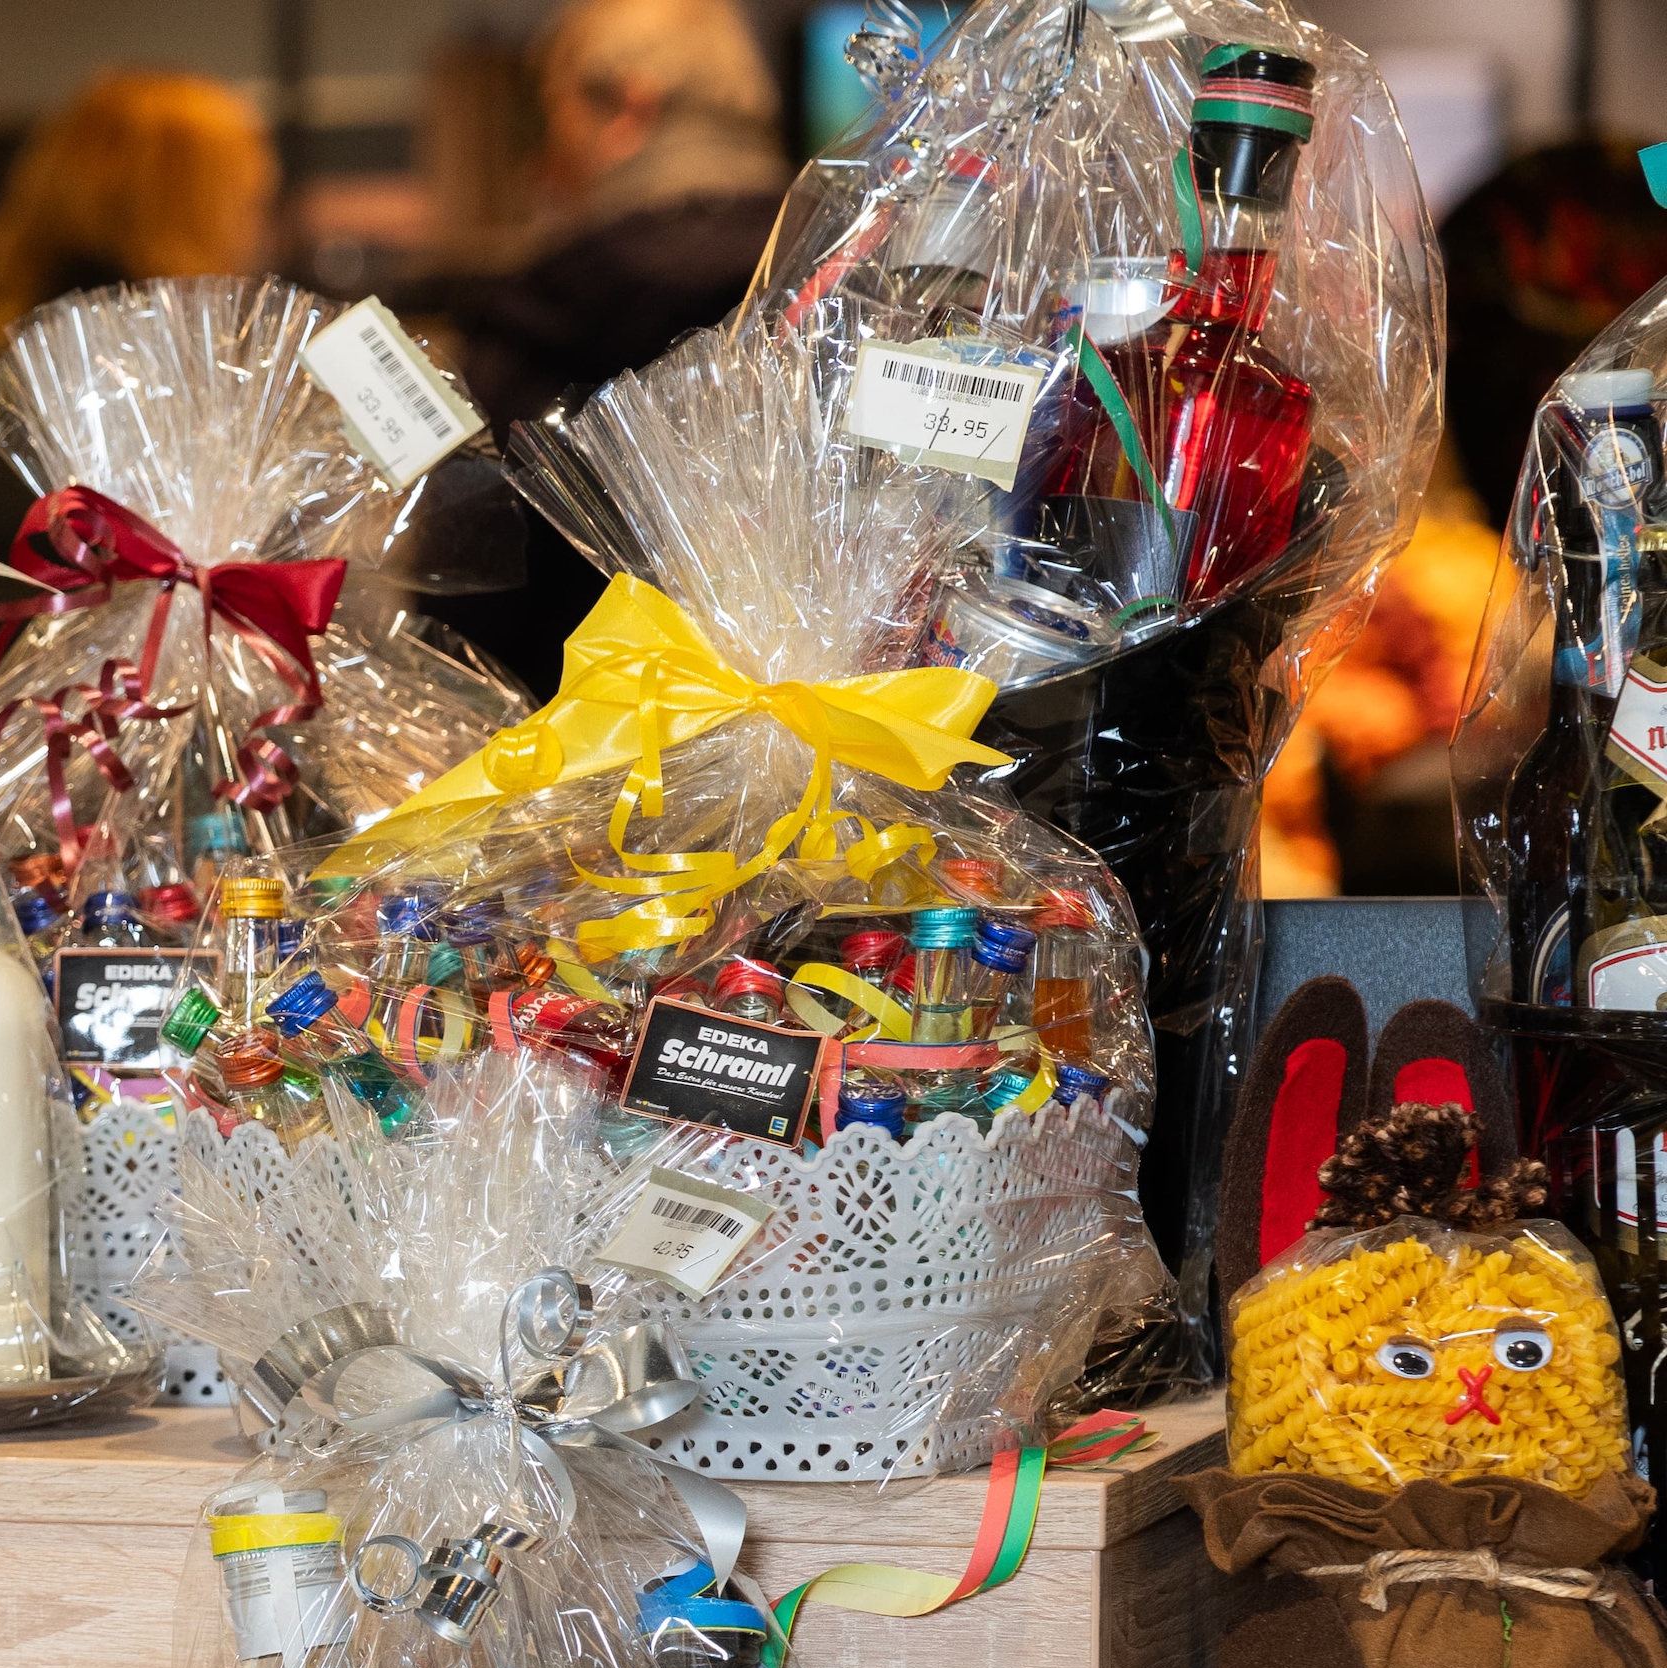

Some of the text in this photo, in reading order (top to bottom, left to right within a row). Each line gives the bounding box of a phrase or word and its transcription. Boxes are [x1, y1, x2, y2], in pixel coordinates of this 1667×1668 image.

[104, 965, 173, 981] EDEKA
[697, 1026, 769, 1055] EDEKA
[658, 1038, 797, 1088] Schraml
[656, 1067, 675, 1079] Das
[675, 1072, 702, 1084] Extra
[716, 1082, 746, 1093] unsere
[746, 1086, 785, 1100] Kunden!
[652, 1240, 695, 1260] 42,95
